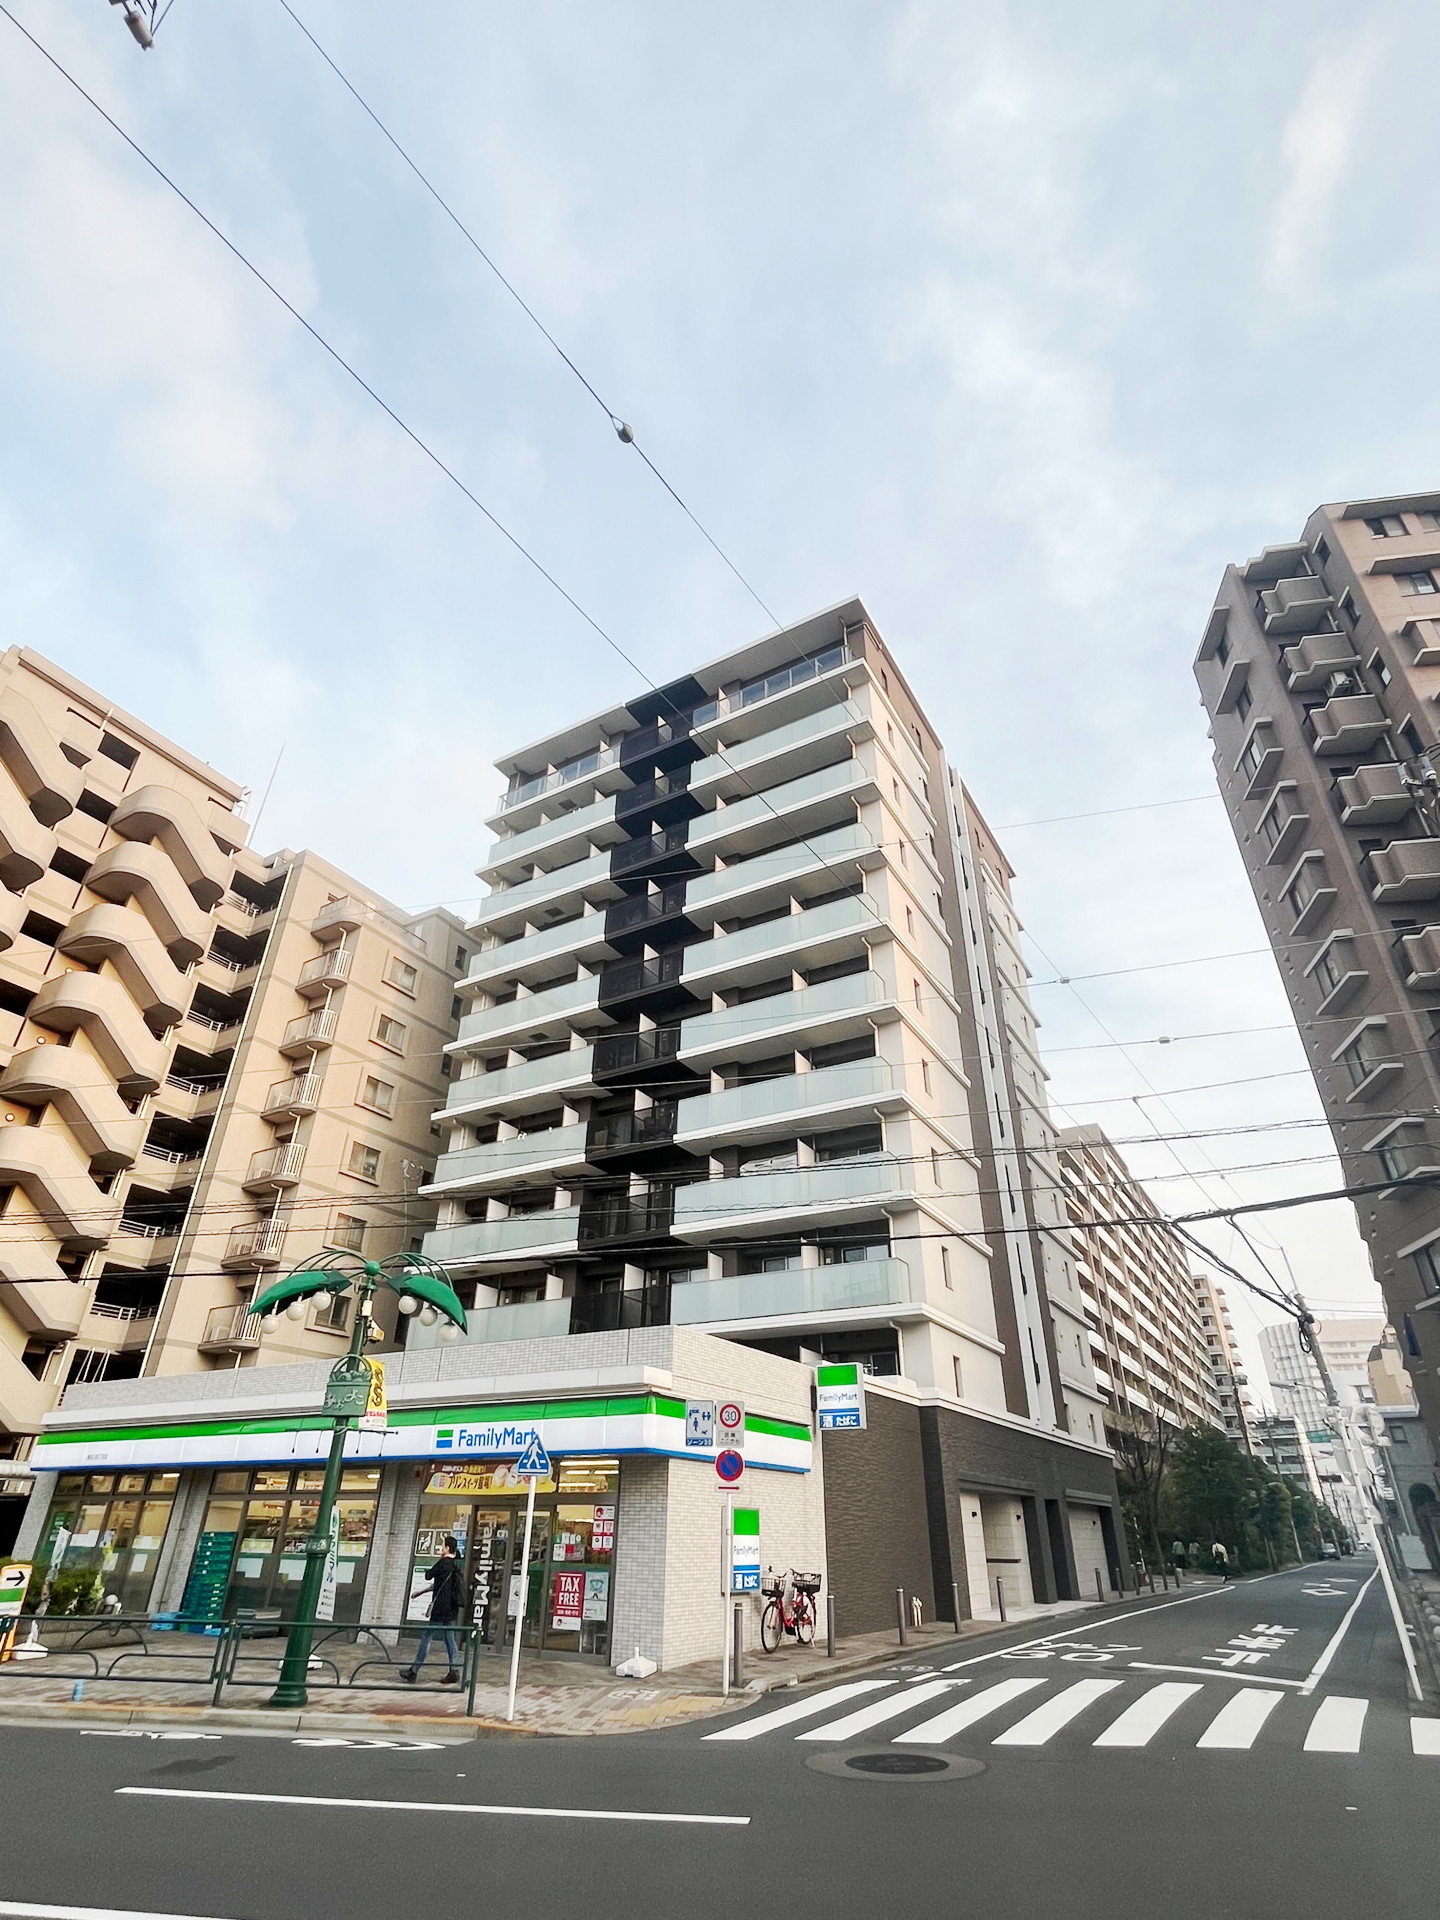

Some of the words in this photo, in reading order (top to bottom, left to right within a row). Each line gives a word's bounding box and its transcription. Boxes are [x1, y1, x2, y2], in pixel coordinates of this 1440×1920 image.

[819, 1393, 858, 1403] FamilyMart
[724, 1410, 737, 1422] 30
[836, 1415, 858, 1426] たばこ
[458, 1427, 536, 1449] FamilyMart
[733, 1545, 759, 1557] FamilyMart
[560, 1576, 580, 1592] TAX
[558, 1592, 579, 1606] FREE
[1000, 1650, 1115, 1662] 30
